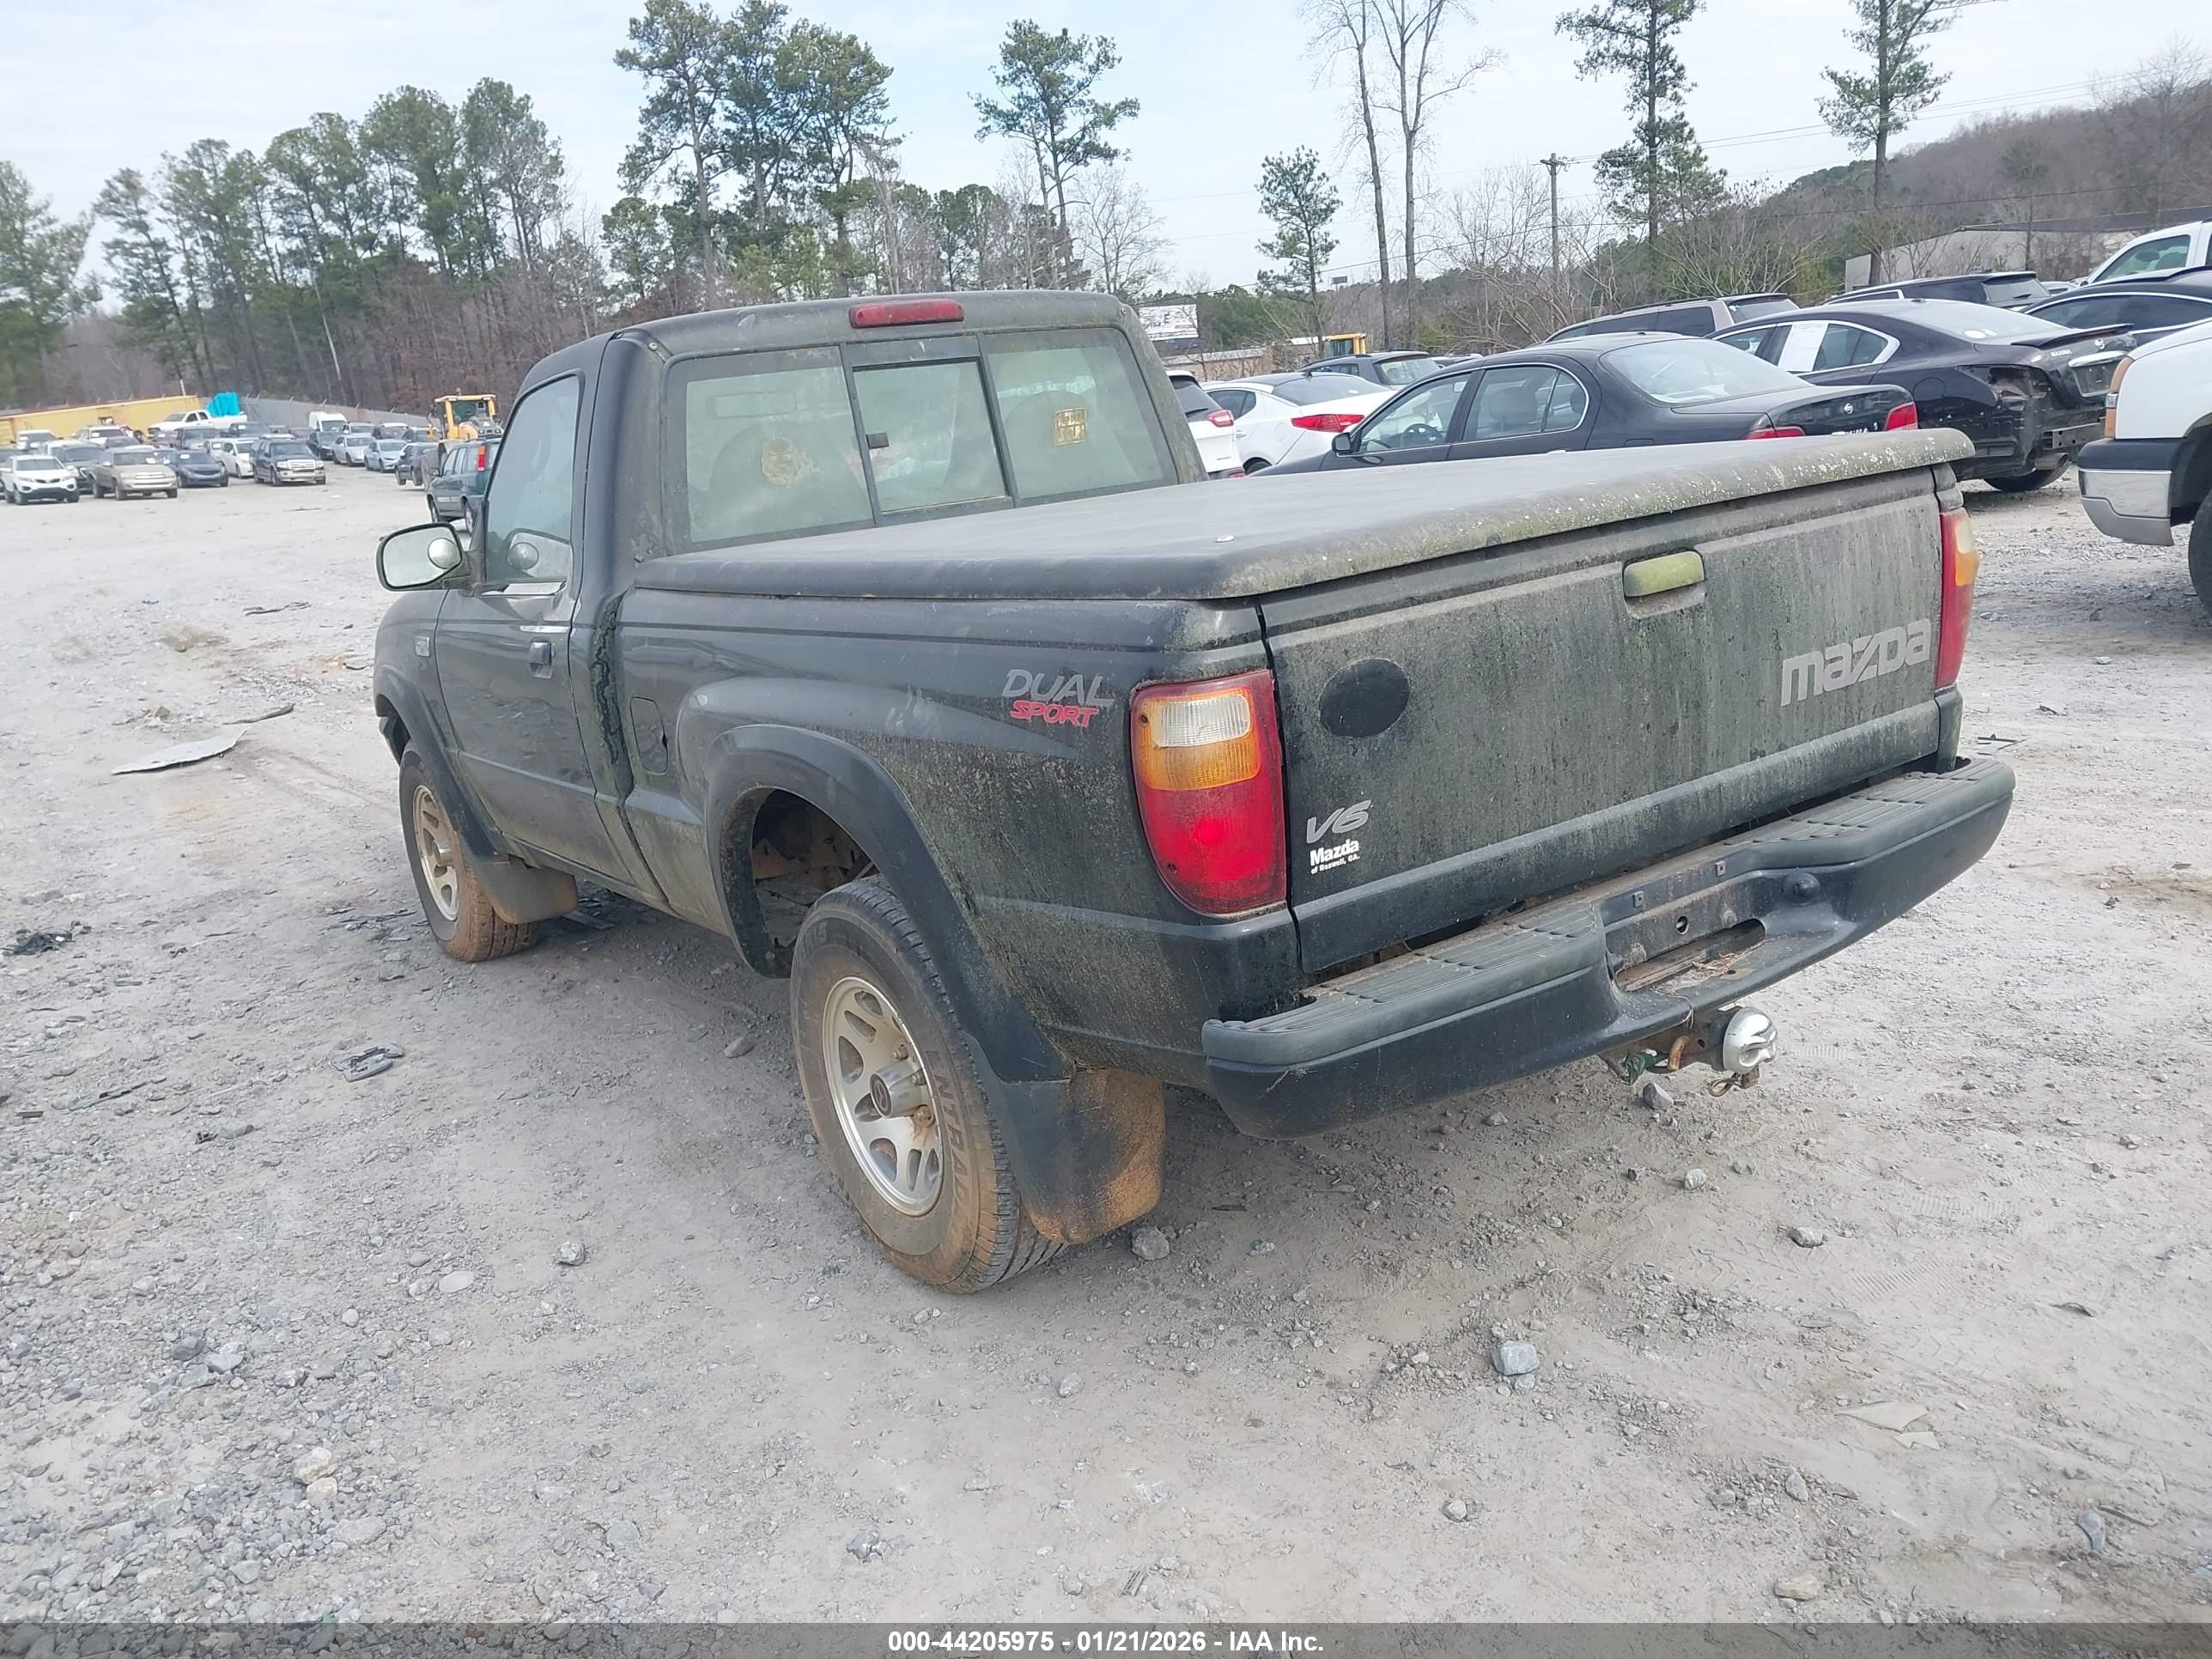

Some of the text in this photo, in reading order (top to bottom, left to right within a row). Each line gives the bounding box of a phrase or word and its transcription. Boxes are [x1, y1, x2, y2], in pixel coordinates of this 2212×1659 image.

[1002, 669, 1115, 707] DUAL
[1010, 700, 1099, 728] SPORT
[1306, 799, 1371, 843] V6
[1310, 838, 1359, 866] Mazda
[1310, 866, 1318, 874] of
